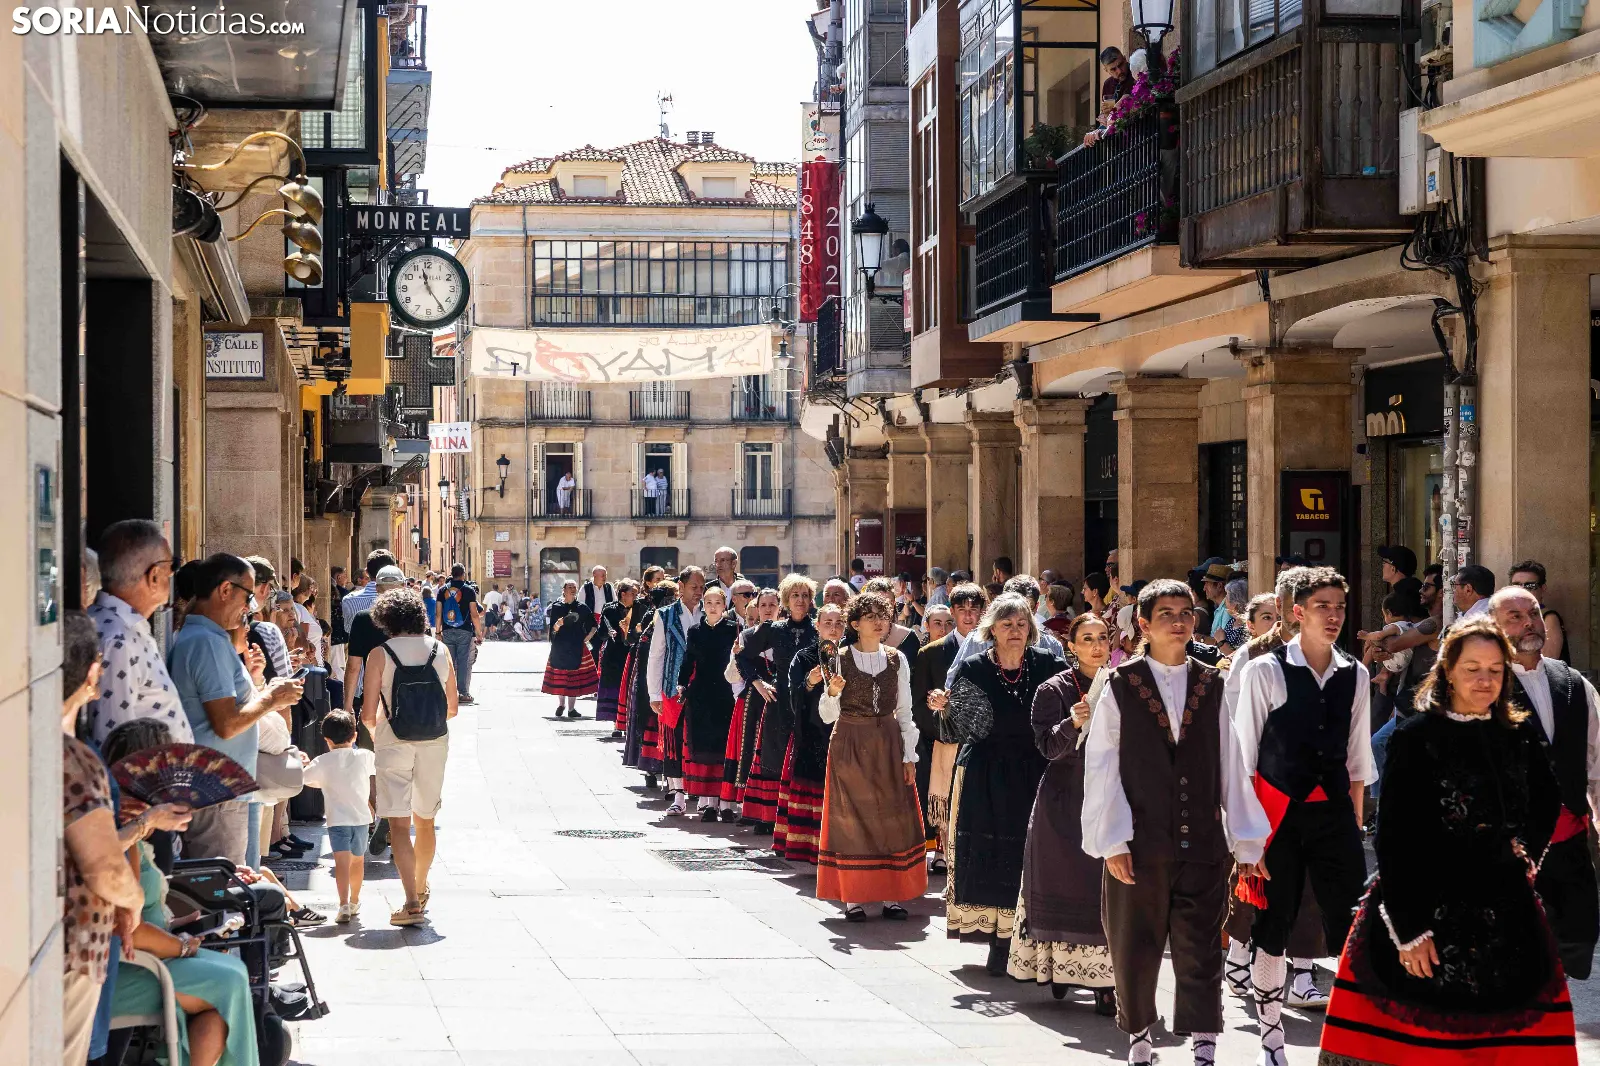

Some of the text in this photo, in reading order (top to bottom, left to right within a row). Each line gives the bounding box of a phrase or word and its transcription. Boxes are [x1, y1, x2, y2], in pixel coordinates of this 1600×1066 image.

[357, 211, 462, 231] MONREAL
[801, 170, 814, 264] 1848
[224, 339, 258, 350] CALLE
[206, 360, 261, 374] NSTITUTO
